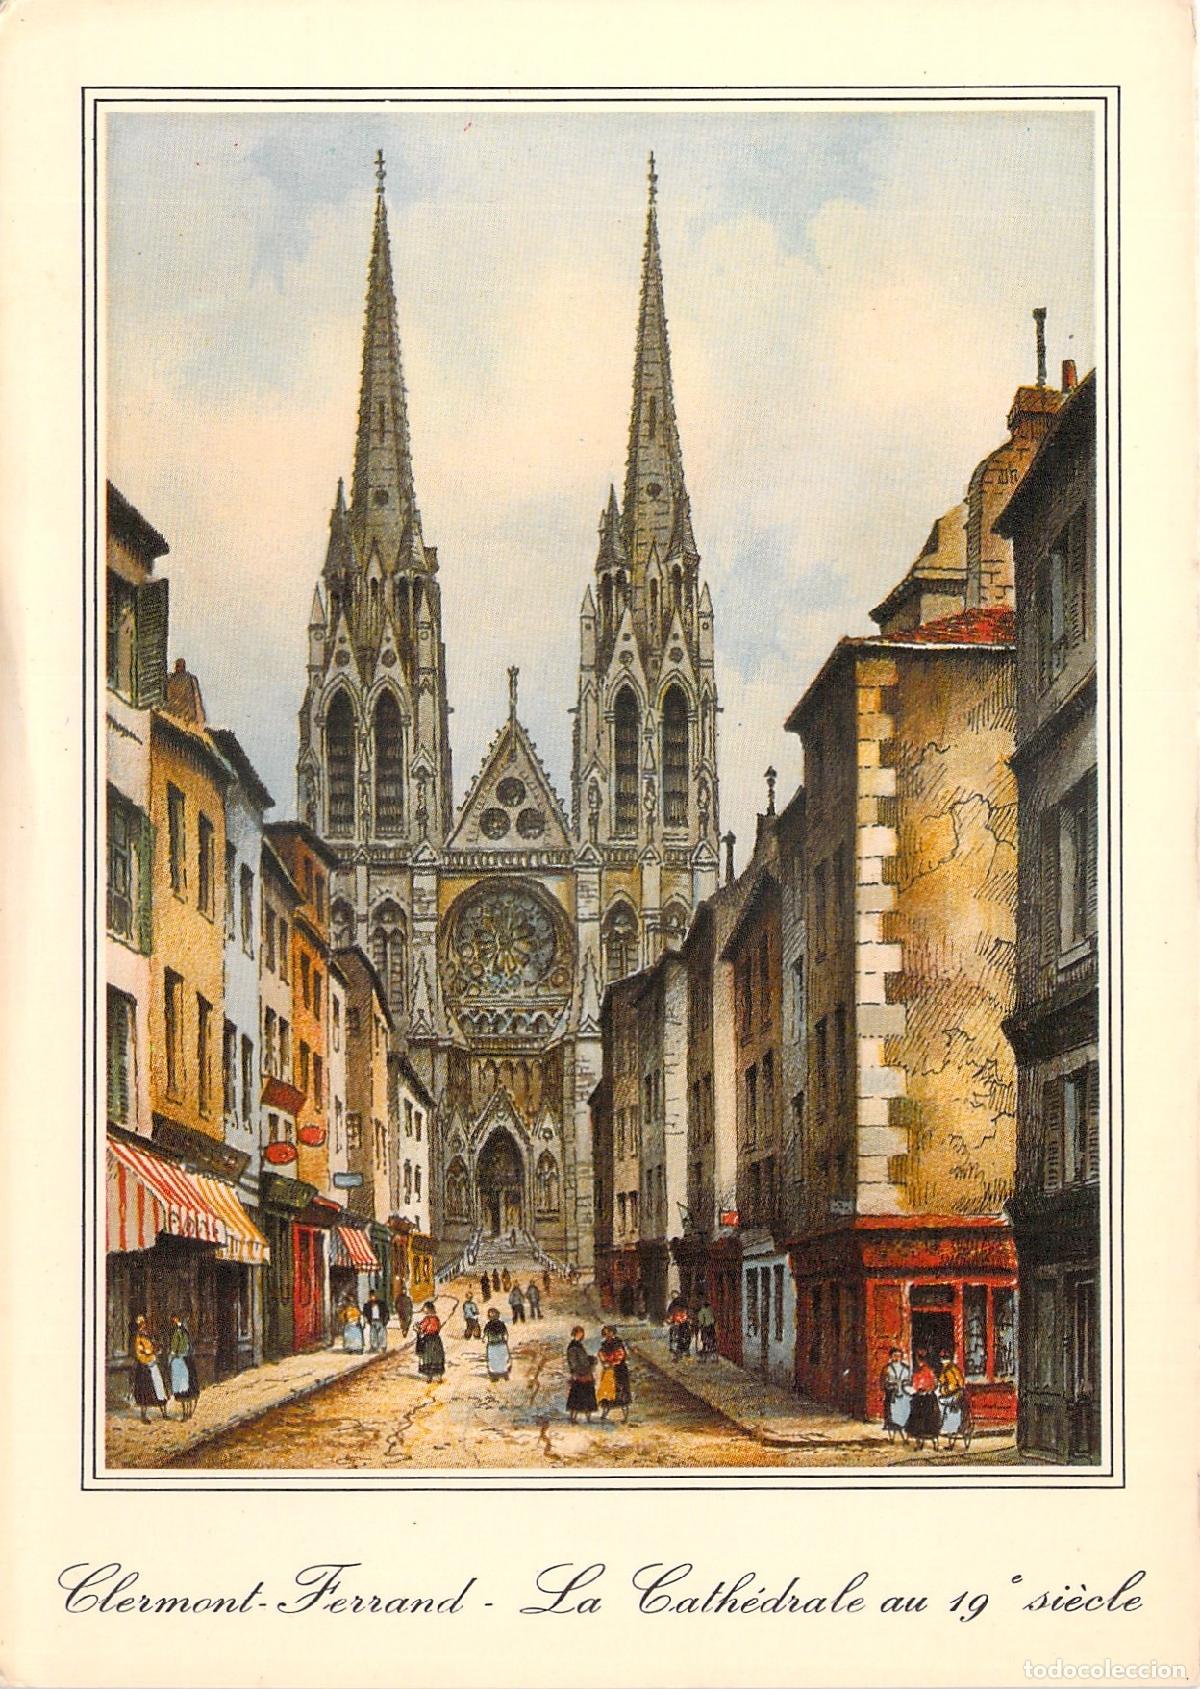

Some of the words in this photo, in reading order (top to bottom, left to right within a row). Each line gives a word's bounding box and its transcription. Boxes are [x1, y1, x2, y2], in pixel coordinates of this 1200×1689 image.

[57, 1562, 477, 1614] Clermont-Ferrand
[519, 1562, 605, 1614] La
[632, 1562, 868, 1614] Cathédrale
[880, 1596, 927, 1612] au
[1022, 1570, 1147, 1612] siècle
